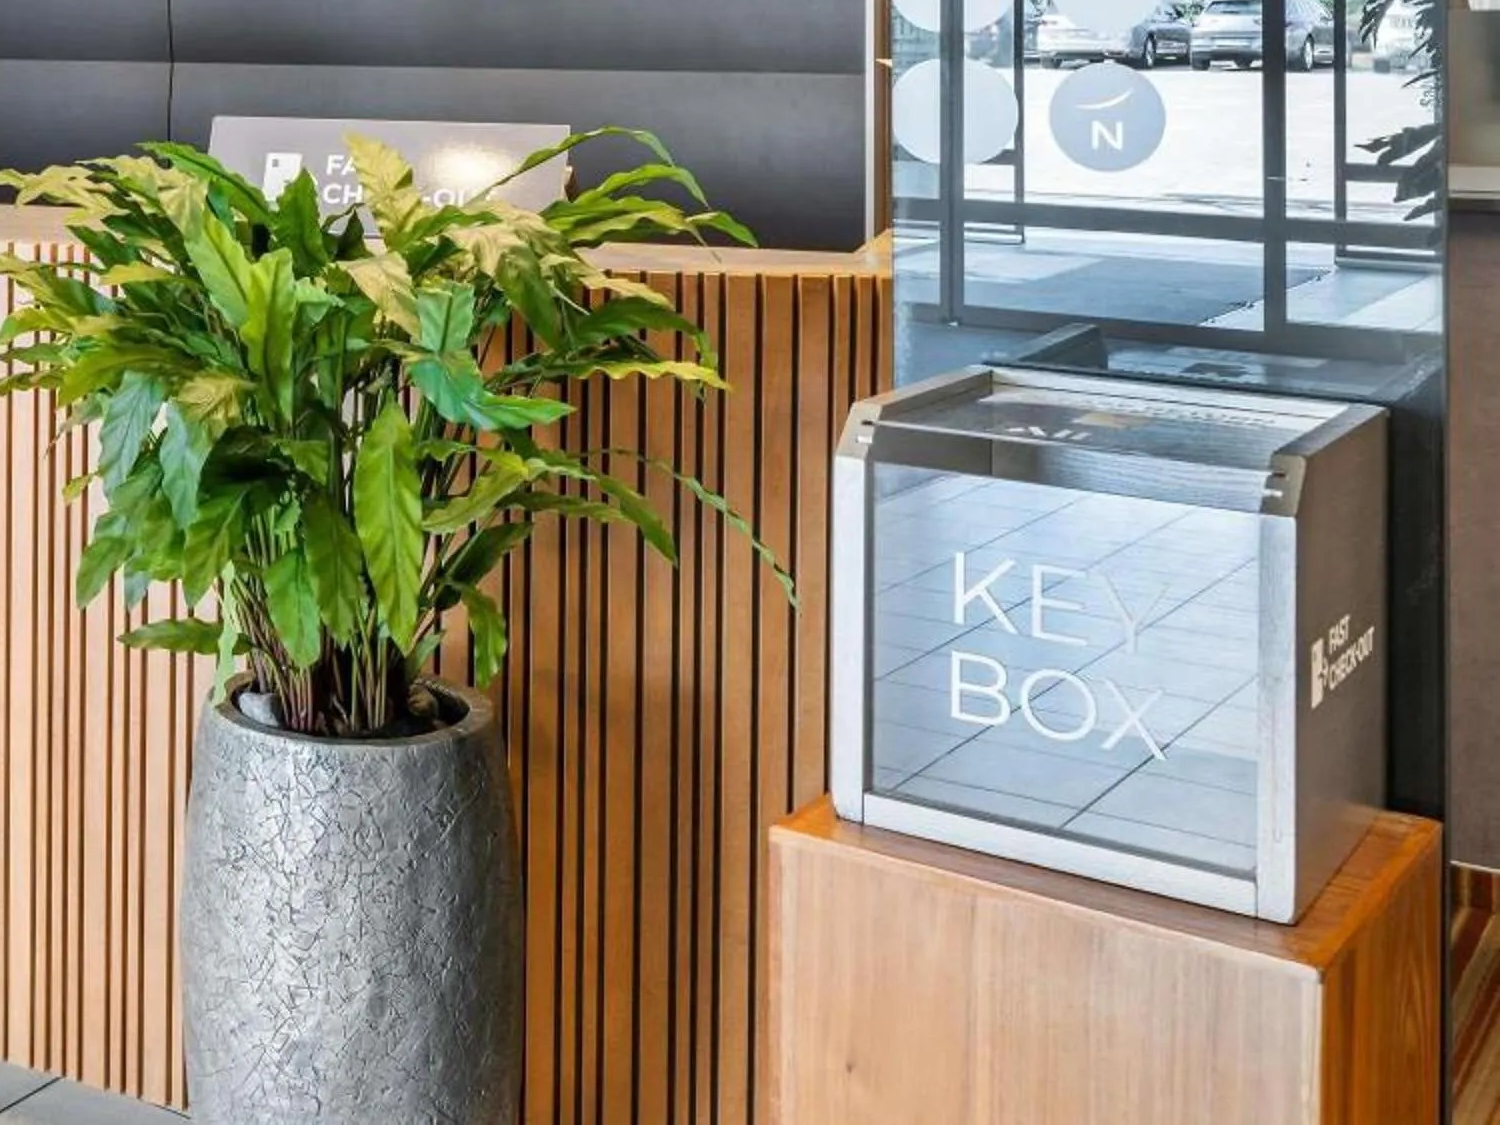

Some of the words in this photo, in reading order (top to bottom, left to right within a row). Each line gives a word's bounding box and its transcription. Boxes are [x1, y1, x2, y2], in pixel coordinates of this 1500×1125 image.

[1091, 120, 1123, 150] N
[954, 551, 1172, 654] KEY
[1329, 614, 1351, 655] FAST
[1329, 626, 1375, 691] CHECK-OUT
[951, 650, 1168, 761] BOX
